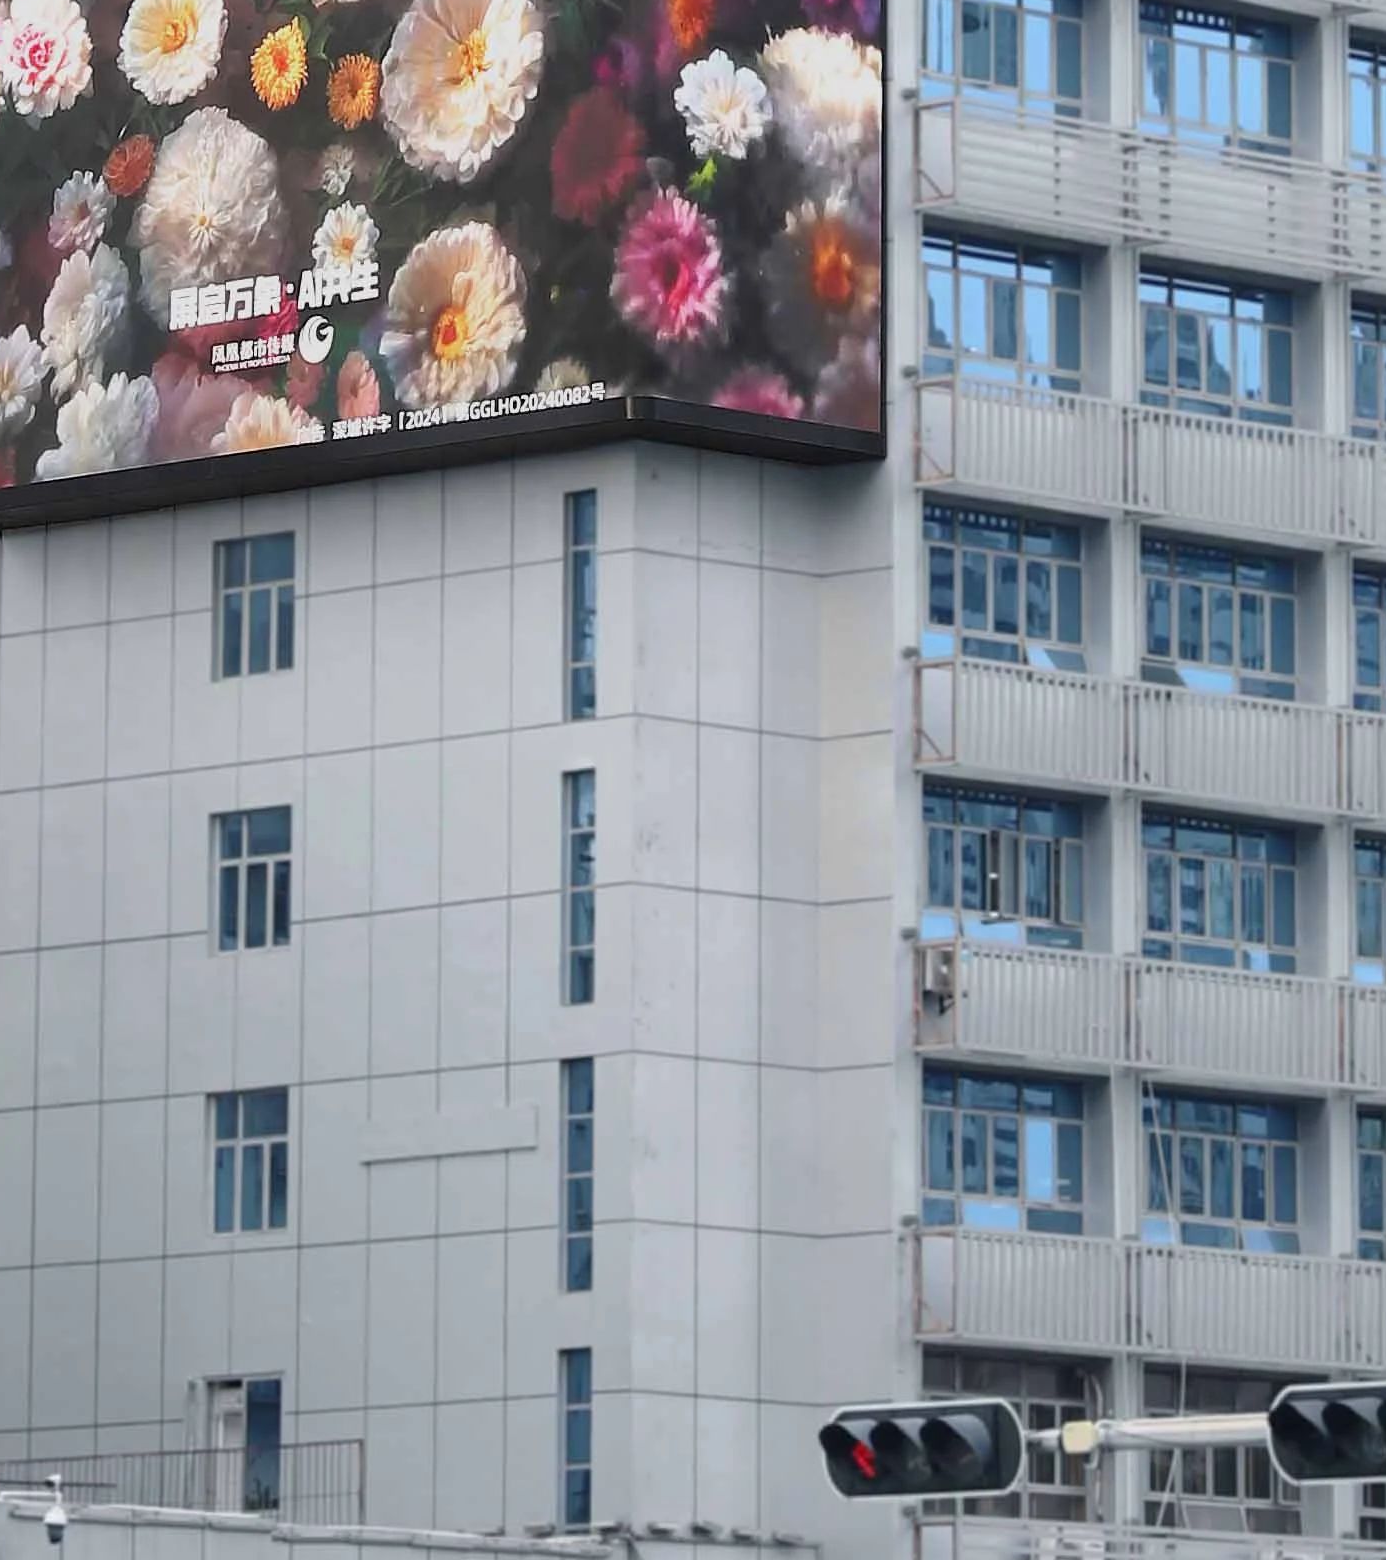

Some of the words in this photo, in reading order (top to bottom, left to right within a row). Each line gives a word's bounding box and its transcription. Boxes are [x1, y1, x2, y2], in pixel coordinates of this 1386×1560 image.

[211, 333, 295, 365] 凤凰都市传媒
